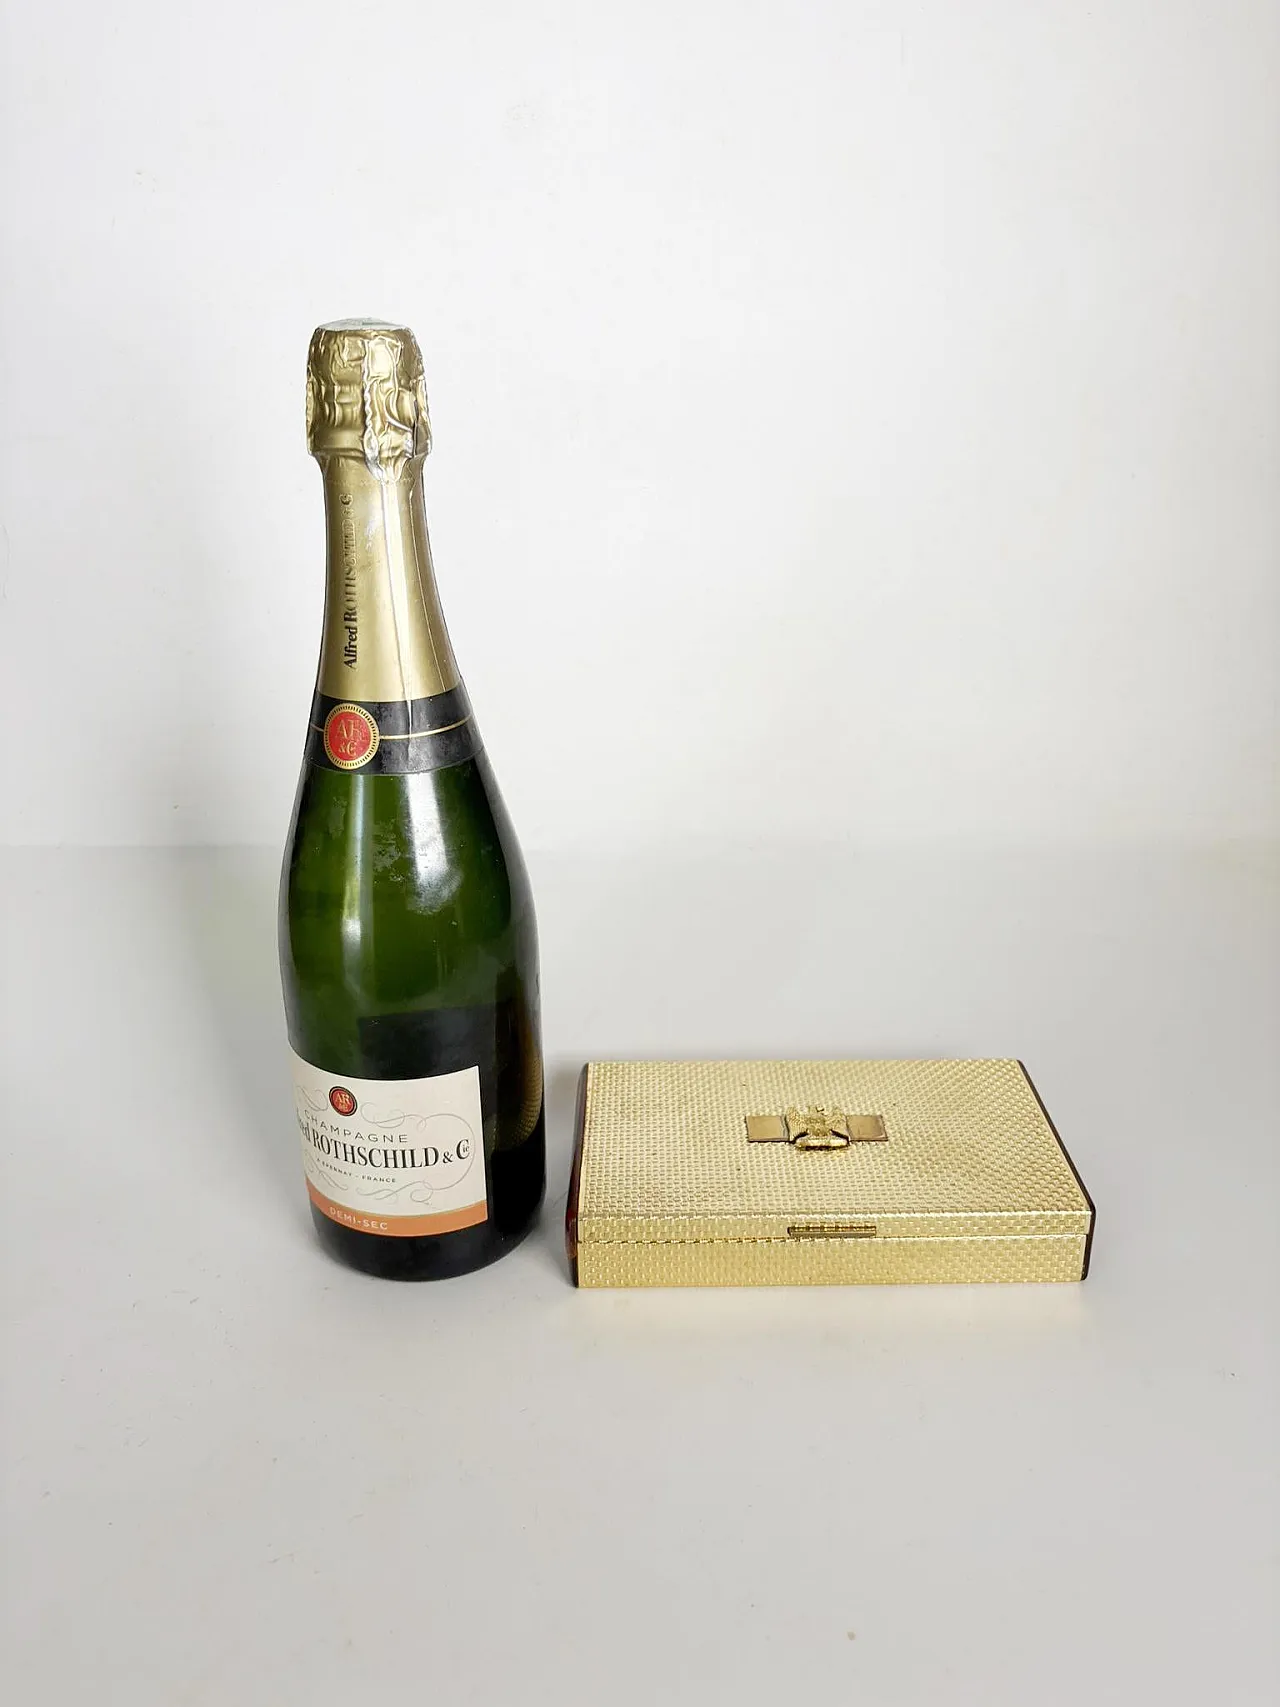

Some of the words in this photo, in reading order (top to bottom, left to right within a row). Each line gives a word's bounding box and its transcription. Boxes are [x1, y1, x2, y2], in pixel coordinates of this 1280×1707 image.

[344, 625, 358, 670] Alfred
[304, 1109, 408, 1143] CHAMPAGNE
[312, 1128, 439, 1169] ROTHSCHILD
[442, 1151, 453, 1164] &
[361, 1175, 396, 1183] FRANCE
[329, 1206, 388, 1230] DEMI-SEC
